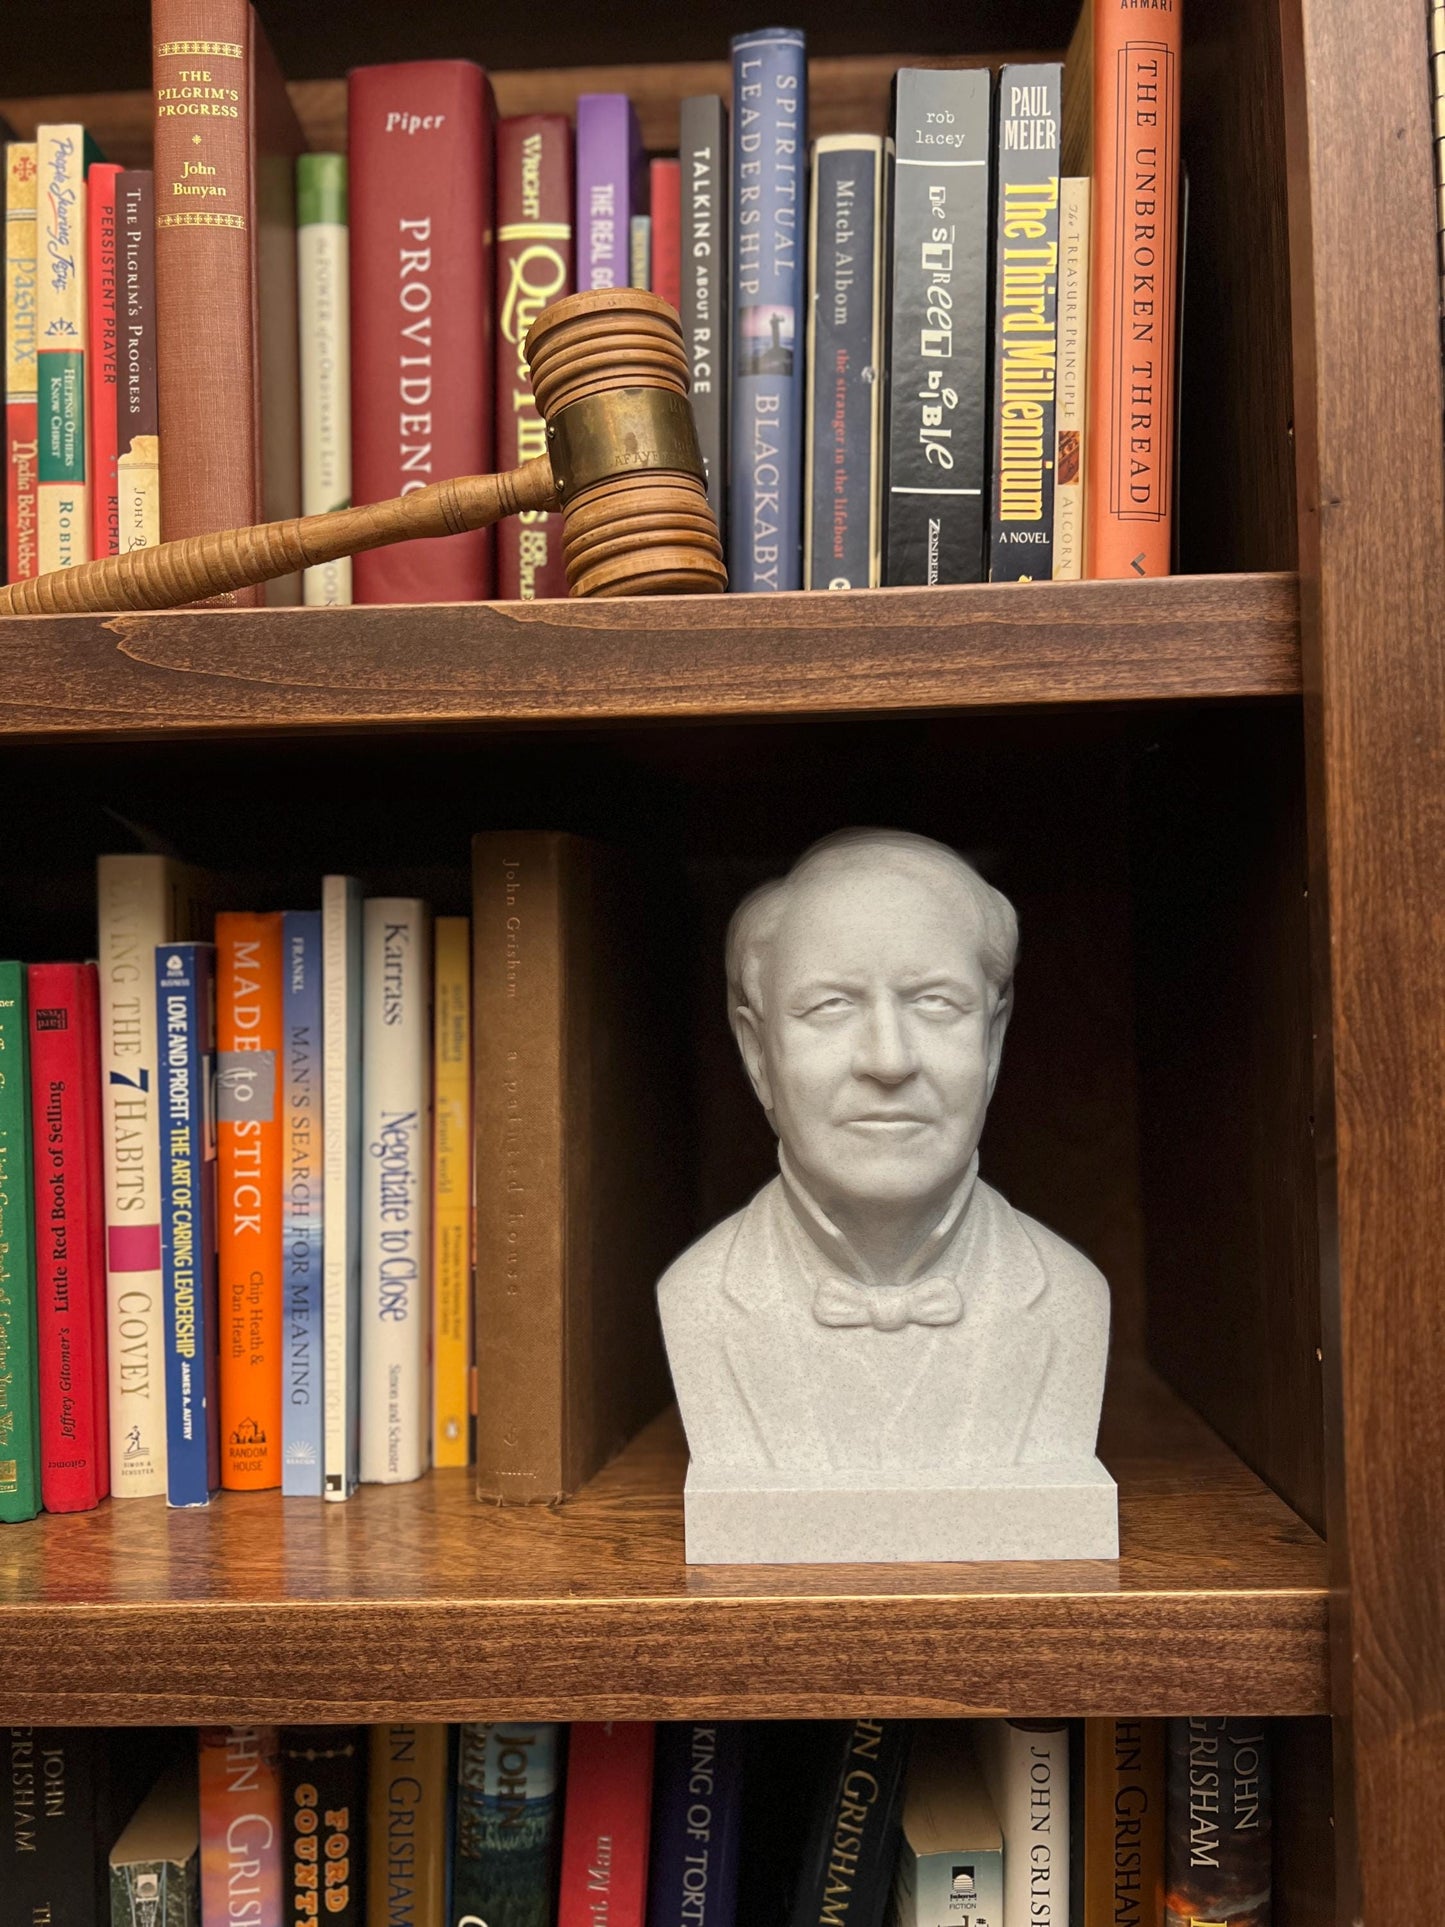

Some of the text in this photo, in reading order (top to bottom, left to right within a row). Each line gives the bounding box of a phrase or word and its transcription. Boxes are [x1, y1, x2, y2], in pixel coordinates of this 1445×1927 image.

[158, 87, 240, 102] PILGRIM'S
[158, 104, 239, 118] PROGRESS
[179, 71, 212, 83] THE
[1010, 86, 1051, 117] PAUL
[385, 112, 446, 135] Piper
[915, 130, 965, 148] lacey
[926, 110, 955, 124] rob
[1004, 119, 1057, 150] MEIER
[127, 188, 141, 224] THE
[172, 183, 227, 199] Bunyan
[181, 162, 216, 179] John
[590, 183, 615, 217] THE
[740, 58, 762, 294] LEADERSHIP
[774, 74, 797, 276] SPIRITUAL
[693, 147, 711, 393] TALKING ABOUT RACE
[834, 180, 855, 325] Mitch Albom
[1065, 233, 1080, 323] TREASURE
[1130, 60, 1158, 504] THE UNBROKEN THREAD
[101, 206, 117, 384] PERSISTENT PRAYER
[128, 325, 143, 413] PROGRESS
[1000, 176, 1059, 521] The Third Millennium
[1063, 329, 1078, 418] PRINCIPLE
[51, 377, 62, 458] KNOW CHRIST
[64, 368, 76, 467] HELPING OTHERS
[107, 495, 119, 556] RICHA
[134, 488, 146, 529] JOHN
[754, 393, 781, 590] BLACKABY
[999, 532, 1050, 544] A NOVEL
[1062, 497, 1074, 569] ALCORN
[292, 937, 304, 994] FRANKL
[502, 859, 521, 998] John Grisham
[383, 923, 408, 1026] Karrass
[112, 997, 142, 1057] THE
[110, 1067, 149, 1093] 7
[233, 941, 261, 1236] MADE to STICK
[114, 1099, 148, 1212] HABITS
[167, 995, 196, 1359] LOVE AND PROFIT THE ART OF CARING LEADERSHIP
[291, 1026, 310, 1405] MAN'S SEARCH FOR MEANING
[369, 1110, 418, 1322] Negotiate to Close
[47, 1081, 76, 1440] Jeffrey Gitomer's Little Red Book of Selling
[118, 1291, 152, 1400] COVEY
[232, 1284, 246, 1358] Dan Heath
[249, 1271, 264, 1366] Chip Heath &
[181, 1362, 191, 1397] JAMES
[182, 1409, 193, 1440] AUTRY
[229, 1447, 267, 1458] RANDOM
[388, 1364, 401, 1474] Simon and Schuster
[233, 1461, 263, 1471] HOUSE
[41, 1749, 65, 1817] JOHN
[495, 1734, 537, 1829] JOHN
[688, 1726, 716, 1796] KING
[1030, 1746, 1051, 1835] JOHN
[1229, 1733, 1264, 1830] JOHN
[324, 1806, 350, 1913] FORD
[686, 1803, 712, 1843] OF
[818, 1769, 879, 1927] GRISHAM
[586, 1834, 612, 1893] Man
[949, 1902, 977, 1910] FICTION
